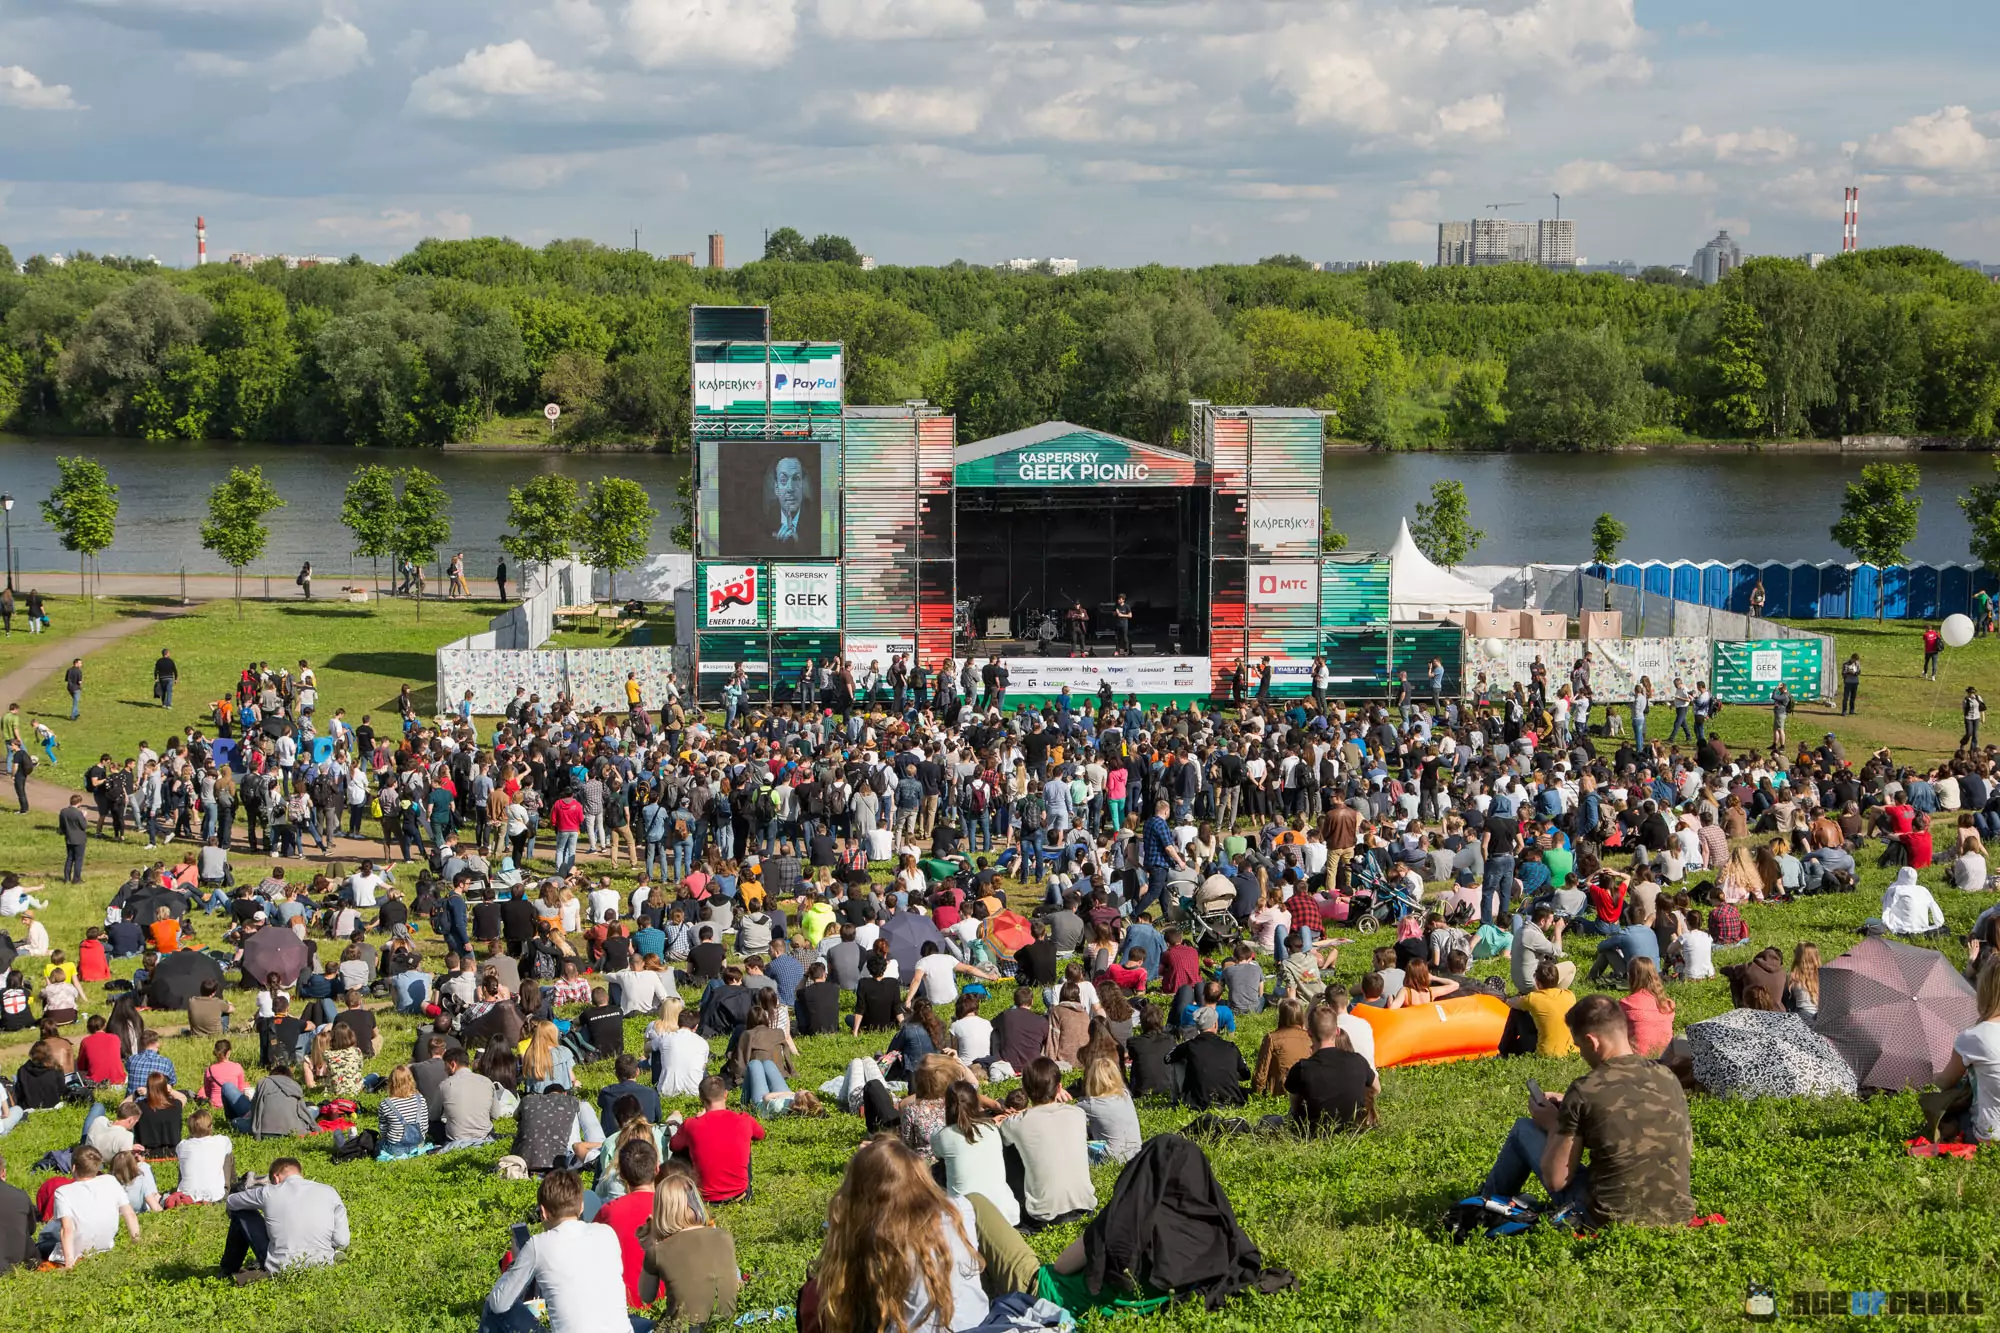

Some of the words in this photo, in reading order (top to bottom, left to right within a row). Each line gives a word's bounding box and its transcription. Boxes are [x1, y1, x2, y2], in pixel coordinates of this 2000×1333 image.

[699, 378, 757, 391] KASPERSKY
[793, 378, 837, 390] PayPal
[1019, 452, 1100, 463] KASPERSKY
[1019, 464, 1075, 480] GEEK
[1080, 464, 1149, 480] PICNIC
[1253, 517, 1309, 530] KASPERSKY
[785, 593, 828, 606] GEEK
[1638, 660, 1660, 668] GEEK
